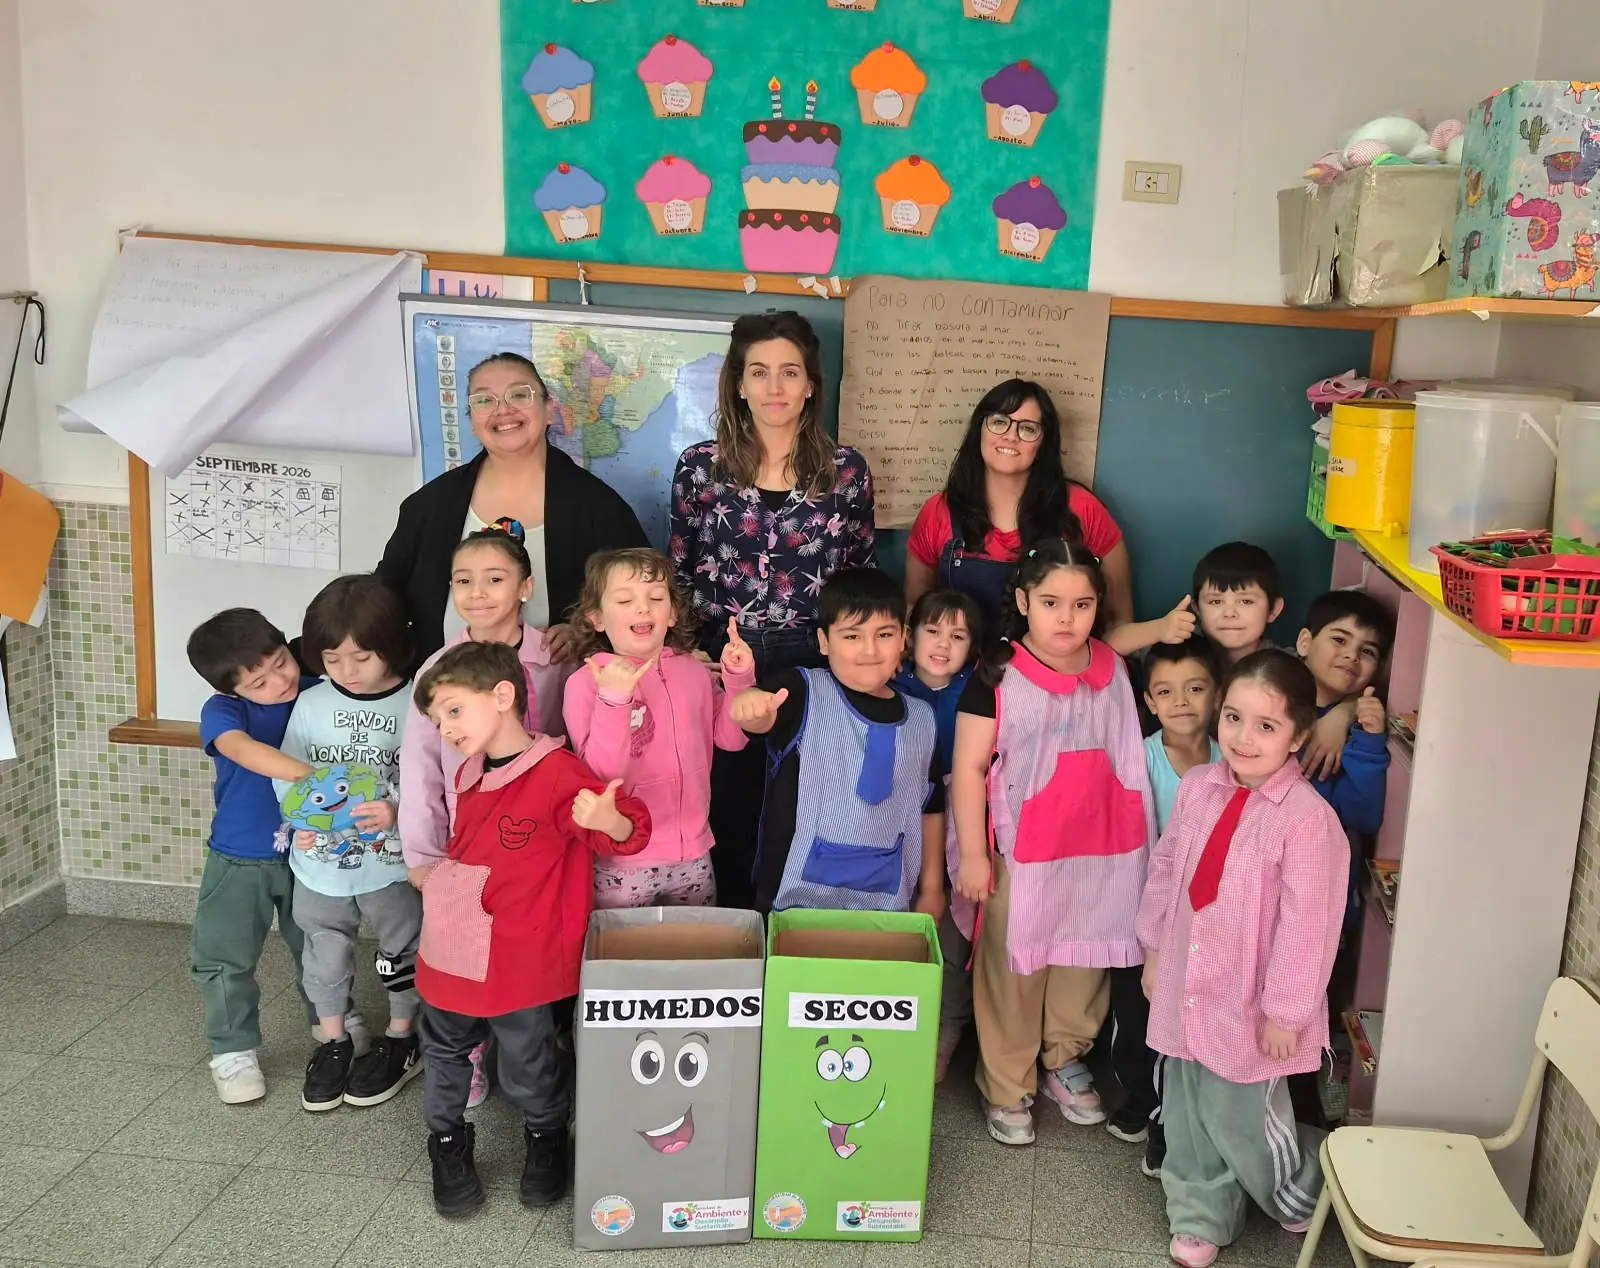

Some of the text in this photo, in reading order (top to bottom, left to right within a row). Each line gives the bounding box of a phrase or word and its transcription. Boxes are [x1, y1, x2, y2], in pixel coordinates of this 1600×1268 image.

[869, 285, 908, 311] Para
[922, 292, 946, 312] no
[282, 465, 312, 479] 2026
[333, 709, 397, 734] BANDA
[350, 732, 369, 743] DE
[584, 996, 760, 1021] HUMEDOS
[804, 1000, 913, 1021] SECOS
[695, 1210, 741, 1218] Ambiente
[868, 1210, 913, 1218] Ambiente
